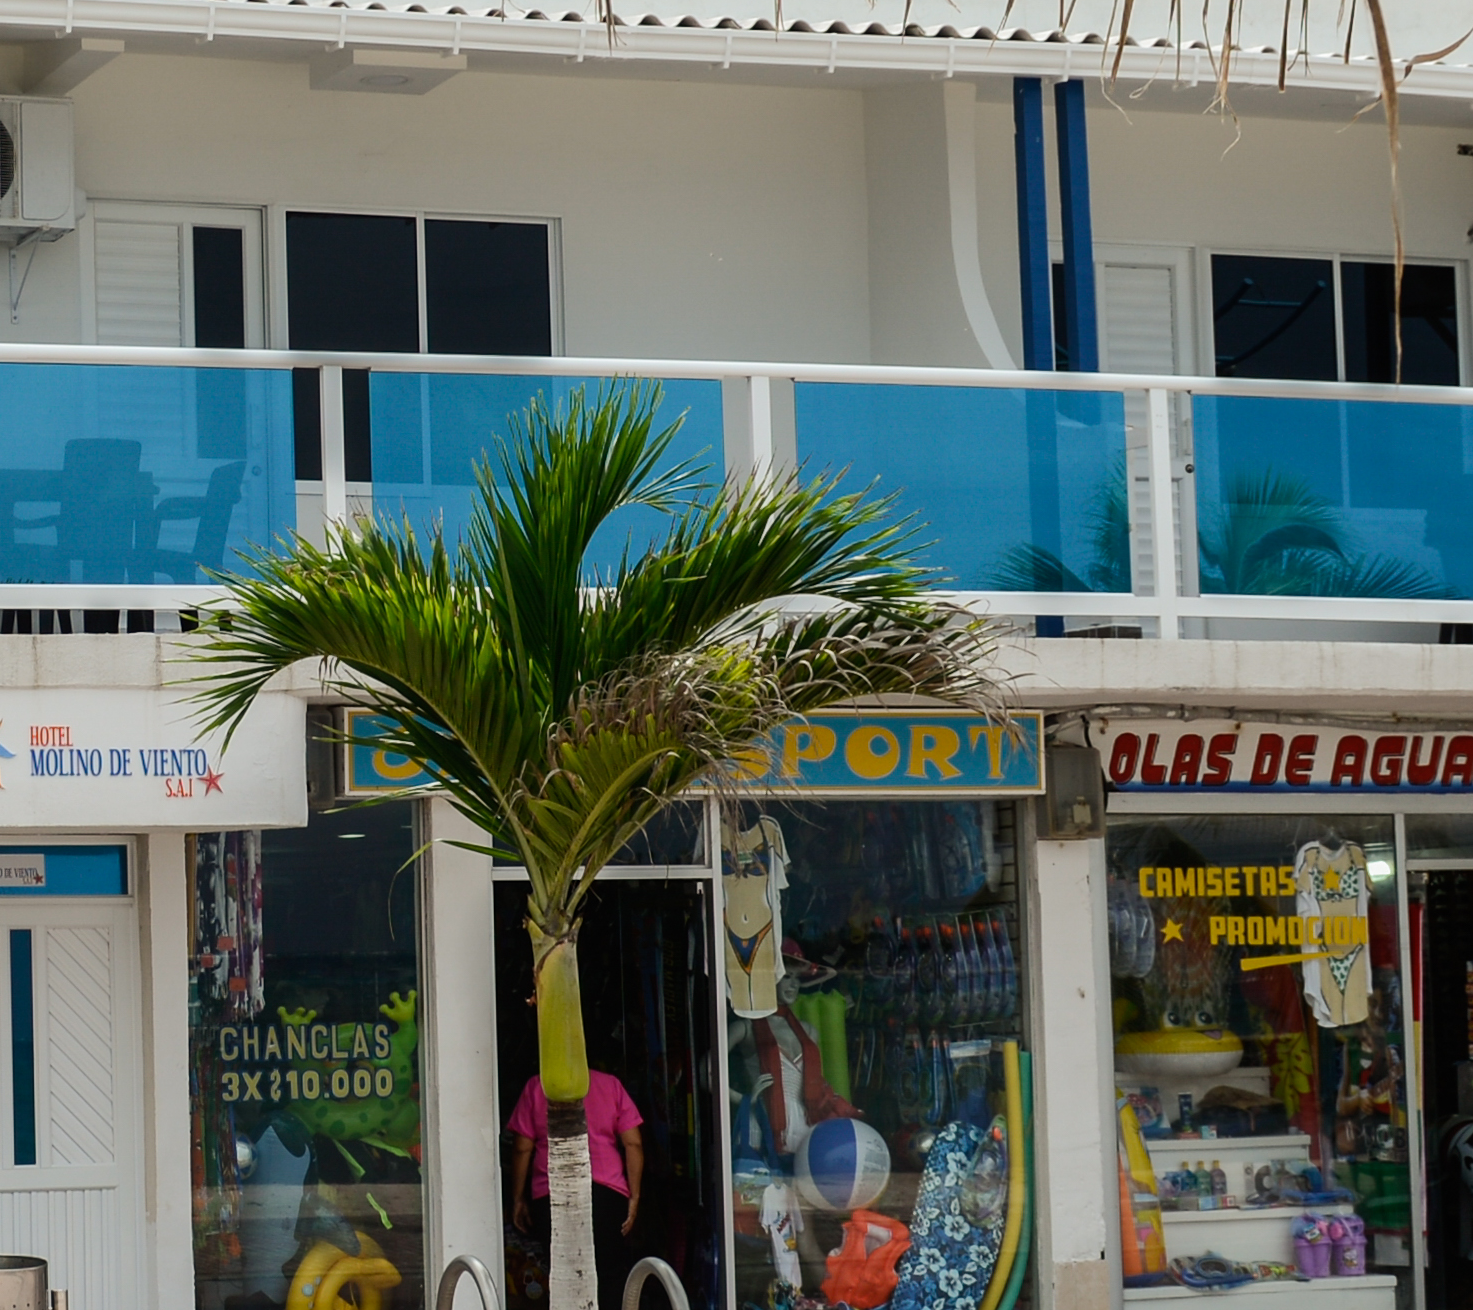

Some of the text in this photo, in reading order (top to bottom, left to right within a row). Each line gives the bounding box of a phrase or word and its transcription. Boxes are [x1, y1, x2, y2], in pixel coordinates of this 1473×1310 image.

[30, 726, 73, 746] HOTEL
[30, 749, 207, 776] MOLINO DE VIENTO
[1109, 732, 1238, 785] OLAS
[1250, 733, 1318, 786] DE
[4, 868, 13, 878] DE
[15, 868, 38, 878] VIENTO
[1139, 866, 1296, 898] CAMISETAS
[1209, 916, 1368, 945] PROMOCION
[219, 1024, 390, 1061] CHANCLAS
